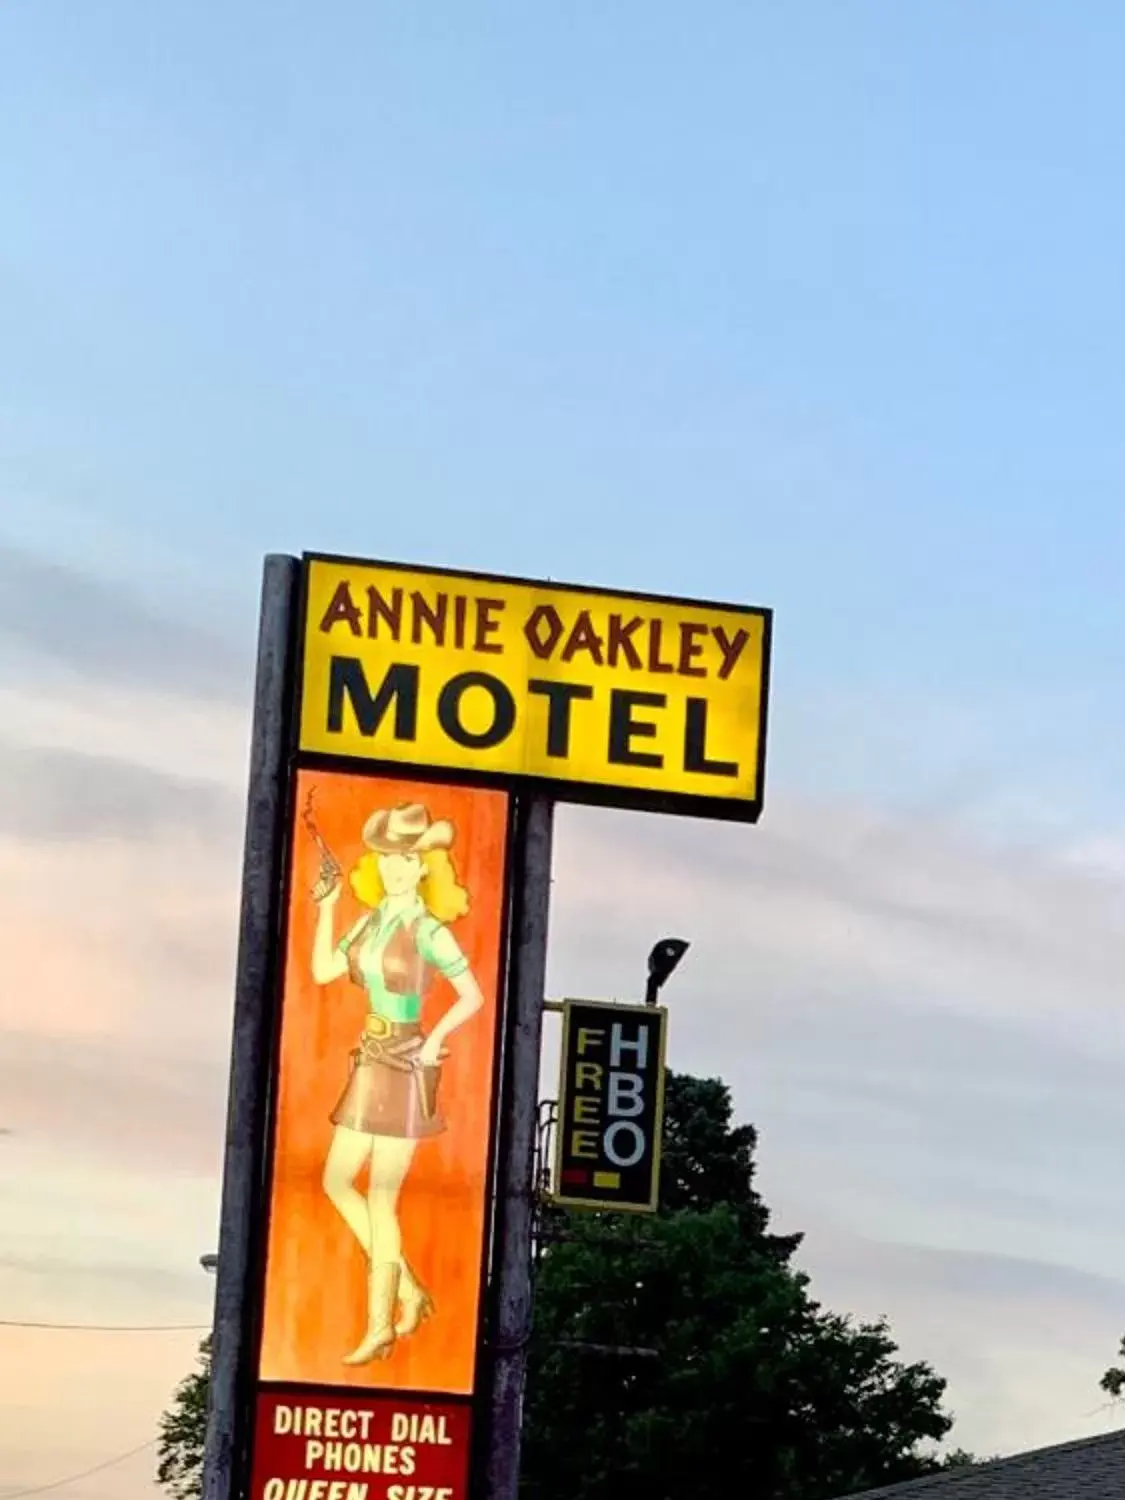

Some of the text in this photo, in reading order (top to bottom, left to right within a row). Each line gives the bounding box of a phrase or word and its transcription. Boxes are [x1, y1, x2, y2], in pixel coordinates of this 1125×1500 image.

[319, 580, 750, 681] ANNIE OAKLEY
[325, 654, 740, 779] MOTEL
[571, 1027, 605, 1158] FREE
[603, 1022, 649, 1167] HBO
[273, 1404, 453, 1445] DIRECT DIAL
[305, 1440, 416, 1476] PHONES
